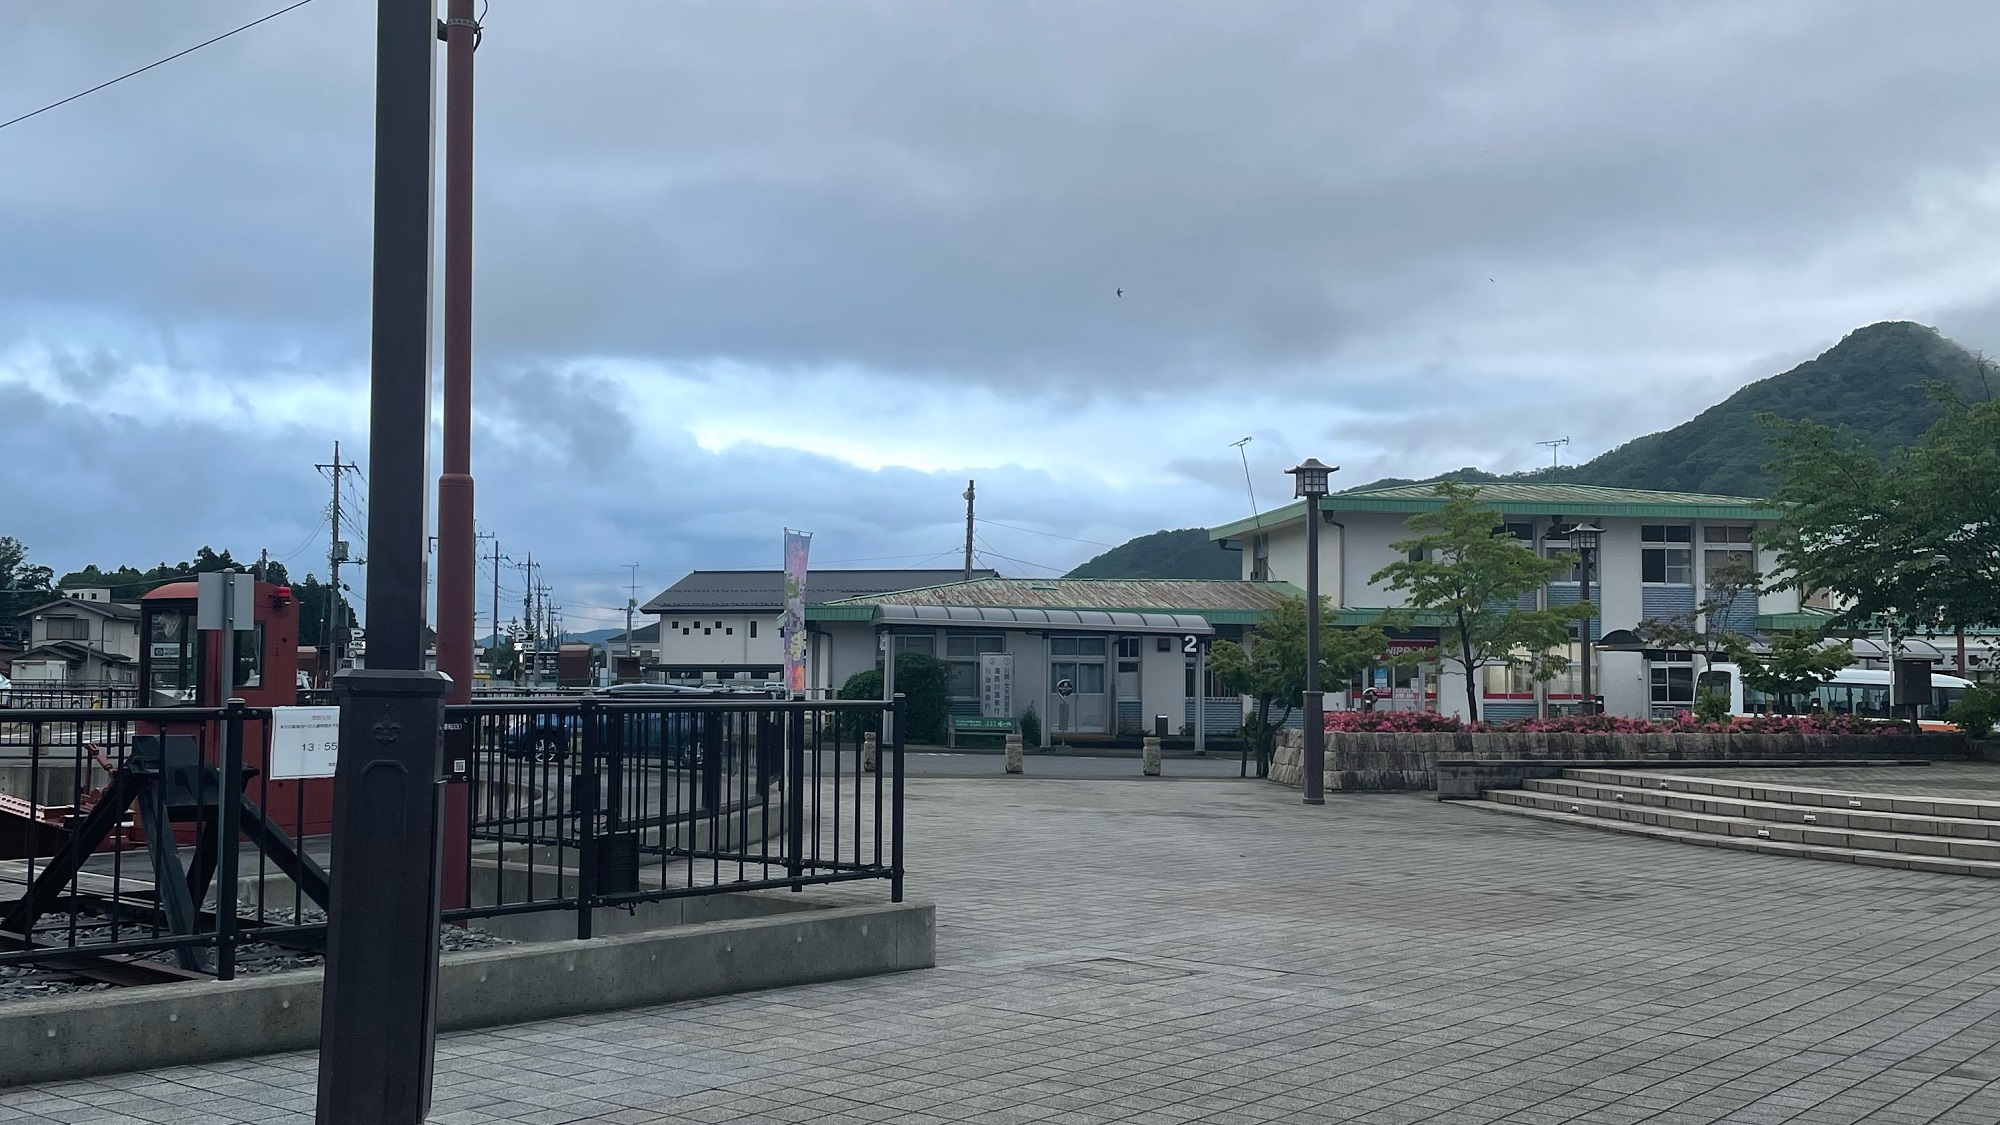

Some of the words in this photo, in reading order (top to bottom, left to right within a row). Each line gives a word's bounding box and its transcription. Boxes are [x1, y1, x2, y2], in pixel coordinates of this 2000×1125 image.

[351, 629, 364, 640] P
[516, 631, 528, 642] P
[1184, 635, 1197, 652] 2
